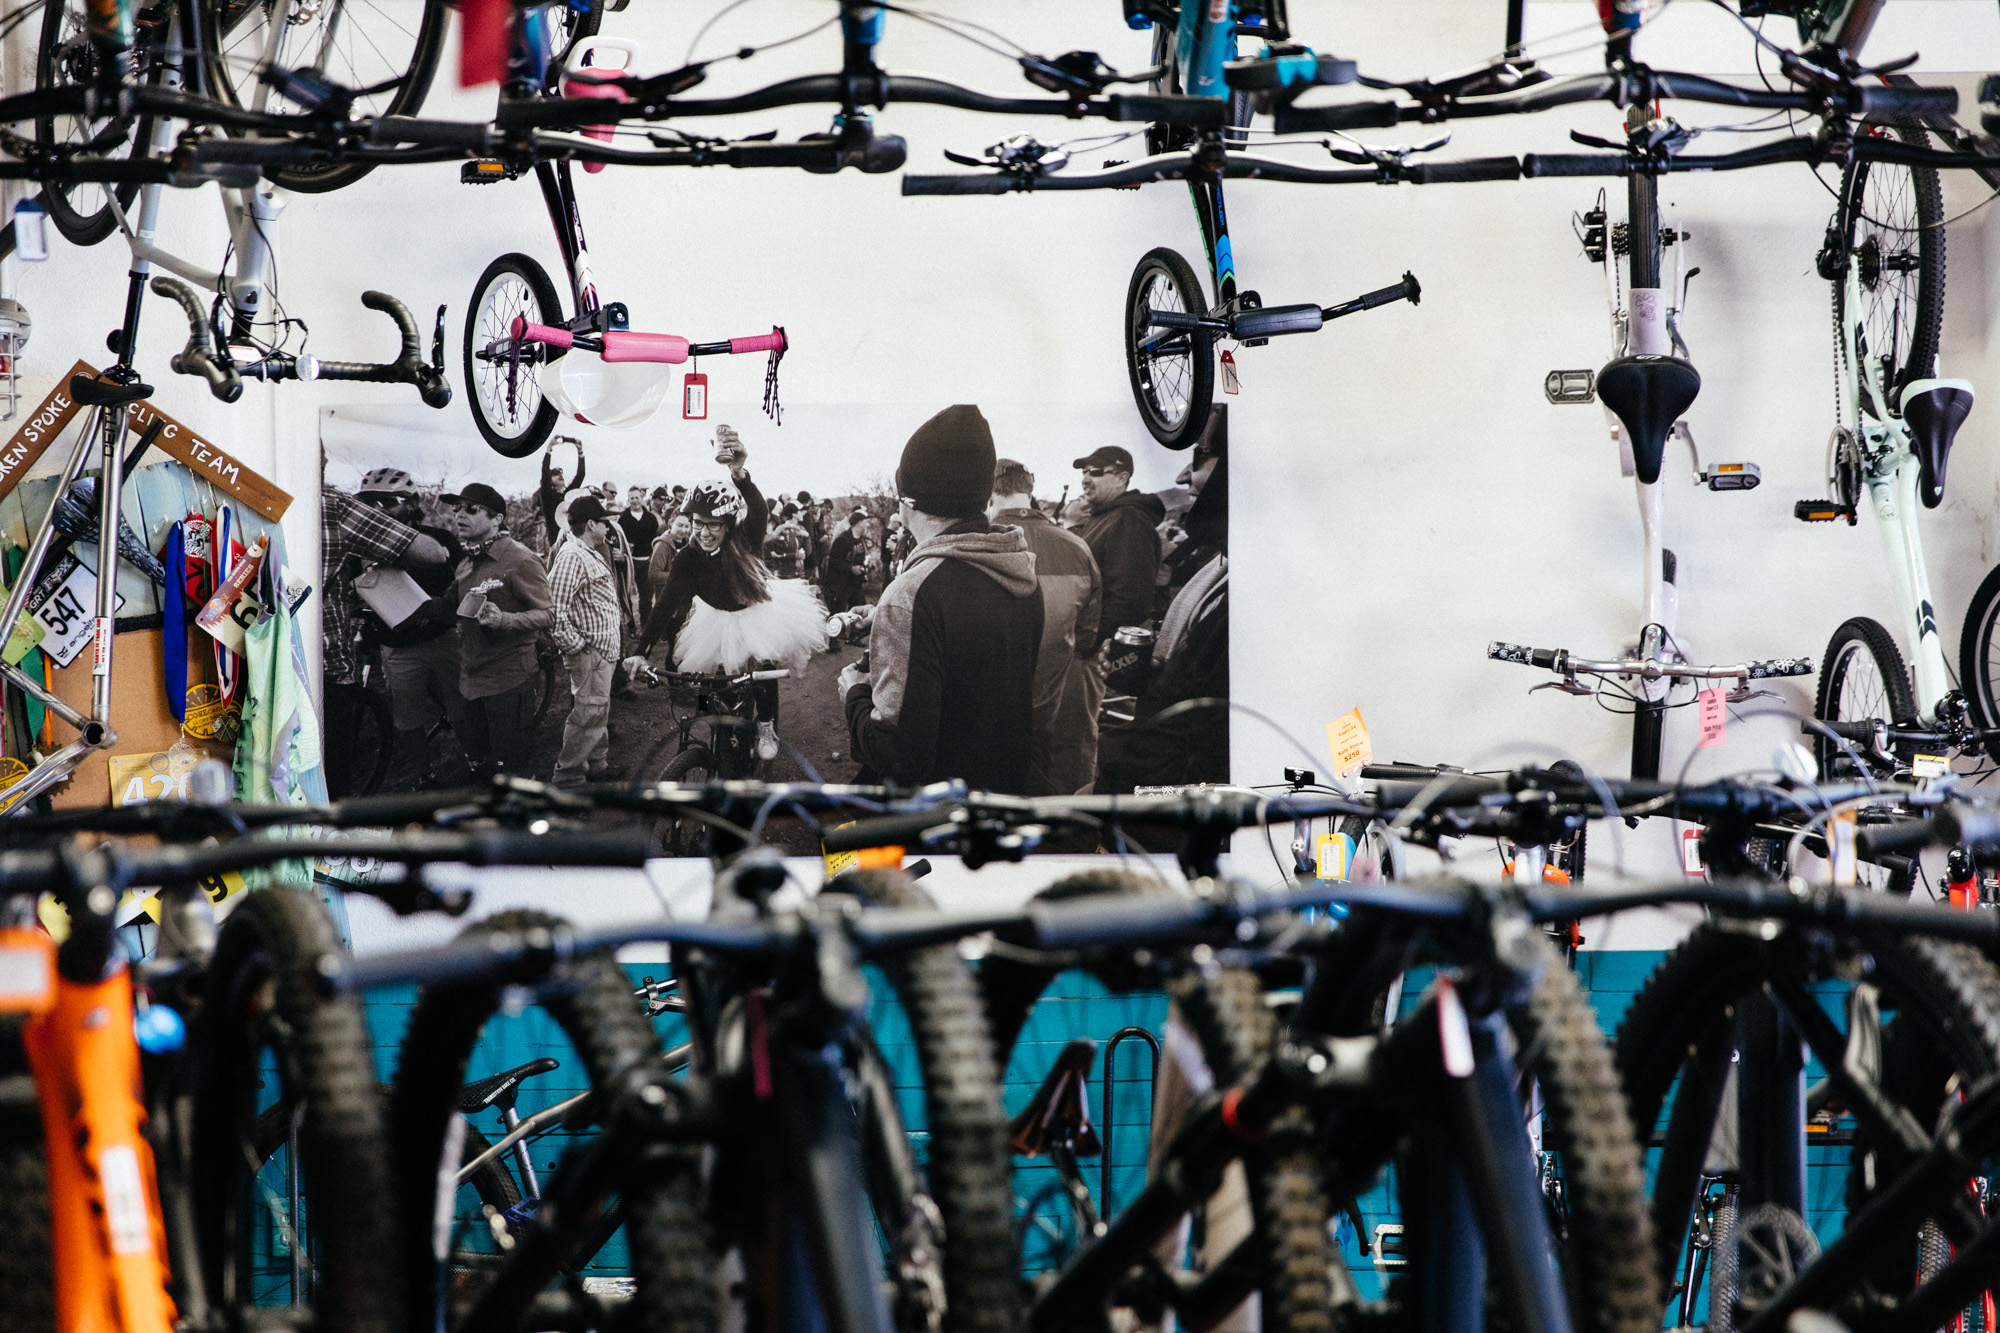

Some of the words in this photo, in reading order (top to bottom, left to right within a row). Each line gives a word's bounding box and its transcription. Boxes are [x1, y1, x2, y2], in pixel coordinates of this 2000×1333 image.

[24, 392, 72, 442] SPOKE
[128, 402, 179, 439] CLIG
[233, 563, 254, 589] SERIES
[29, 588, 47, 609] GRT
[40, 586, 86, 636] 547
[1344, 749, 1360, 763] $250
[483, 1086, 504, 1104] TRANSITION
[501, 1080, 511, 1090] BIKE
